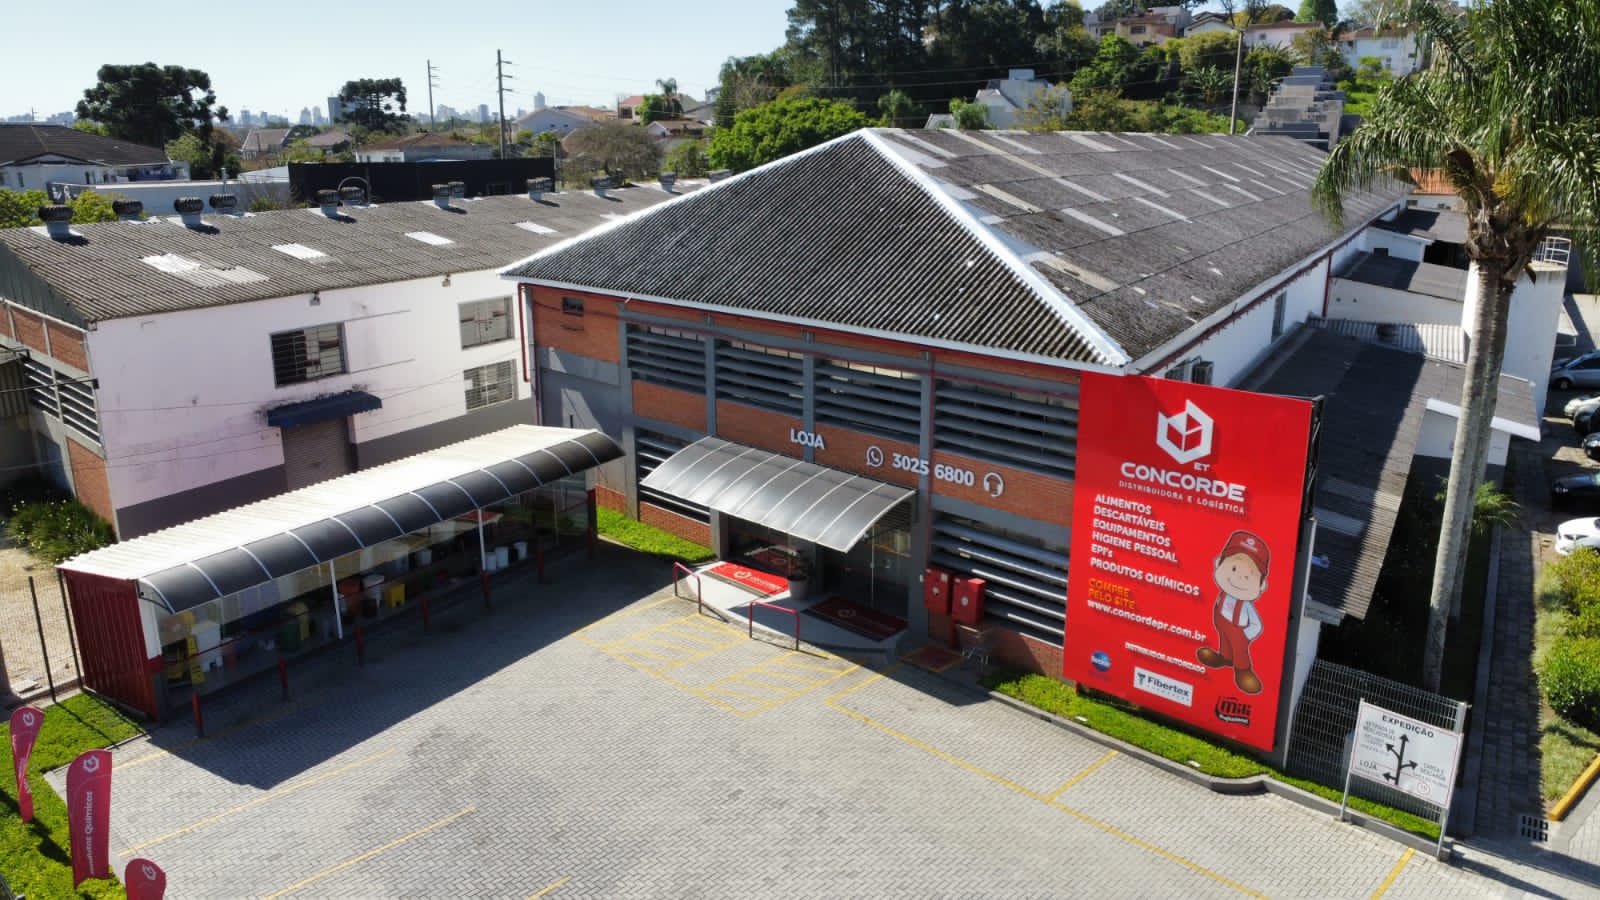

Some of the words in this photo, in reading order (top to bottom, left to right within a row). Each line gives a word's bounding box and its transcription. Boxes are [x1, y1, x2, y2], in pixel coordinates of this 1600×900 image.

[790, 428, 825, 450] LOJA
[892, 452, 930, 476] 3025
[934, 463, 975, 487] 6800
[1193, 462, 1210, 472] ET
[1120, 461, 1246, 502] CONCORDE
[1095, 494, 1152, 515] ALIMENTOS
[1119, 480, 1184, 500] DISTRIBUIDORA
[1187, 495, 1193, 503] E
[1197, 496, 1245, 514] LOGÍSTICA
[1093, 505, 1165, 531] DESCARTÁVEIS
[1092, 518, 1171, 547] EQUIPAMENTOS
[1092, 531, 1132, 549] HIGIENE
[1133, 542, 1178, 562] PESSOAL
[1088, 578, 1131, 598] COMPRE
[1090, 557, 1143, 580] PRODUTOS
[1145, 572, 1200, 596] QUÍMICOS
[1088, 588, 1112, 602] PELO
[1114, 595, 1136, 610] SITE
[1087, 599, 1206, 642] www.concordepr.com.br
[1147, 676, 1190, 697] Fibertex
[1382, 714, 1434, 738] EXPEDIÇÃO
[1359, 759, 1377, 770] LOJA
